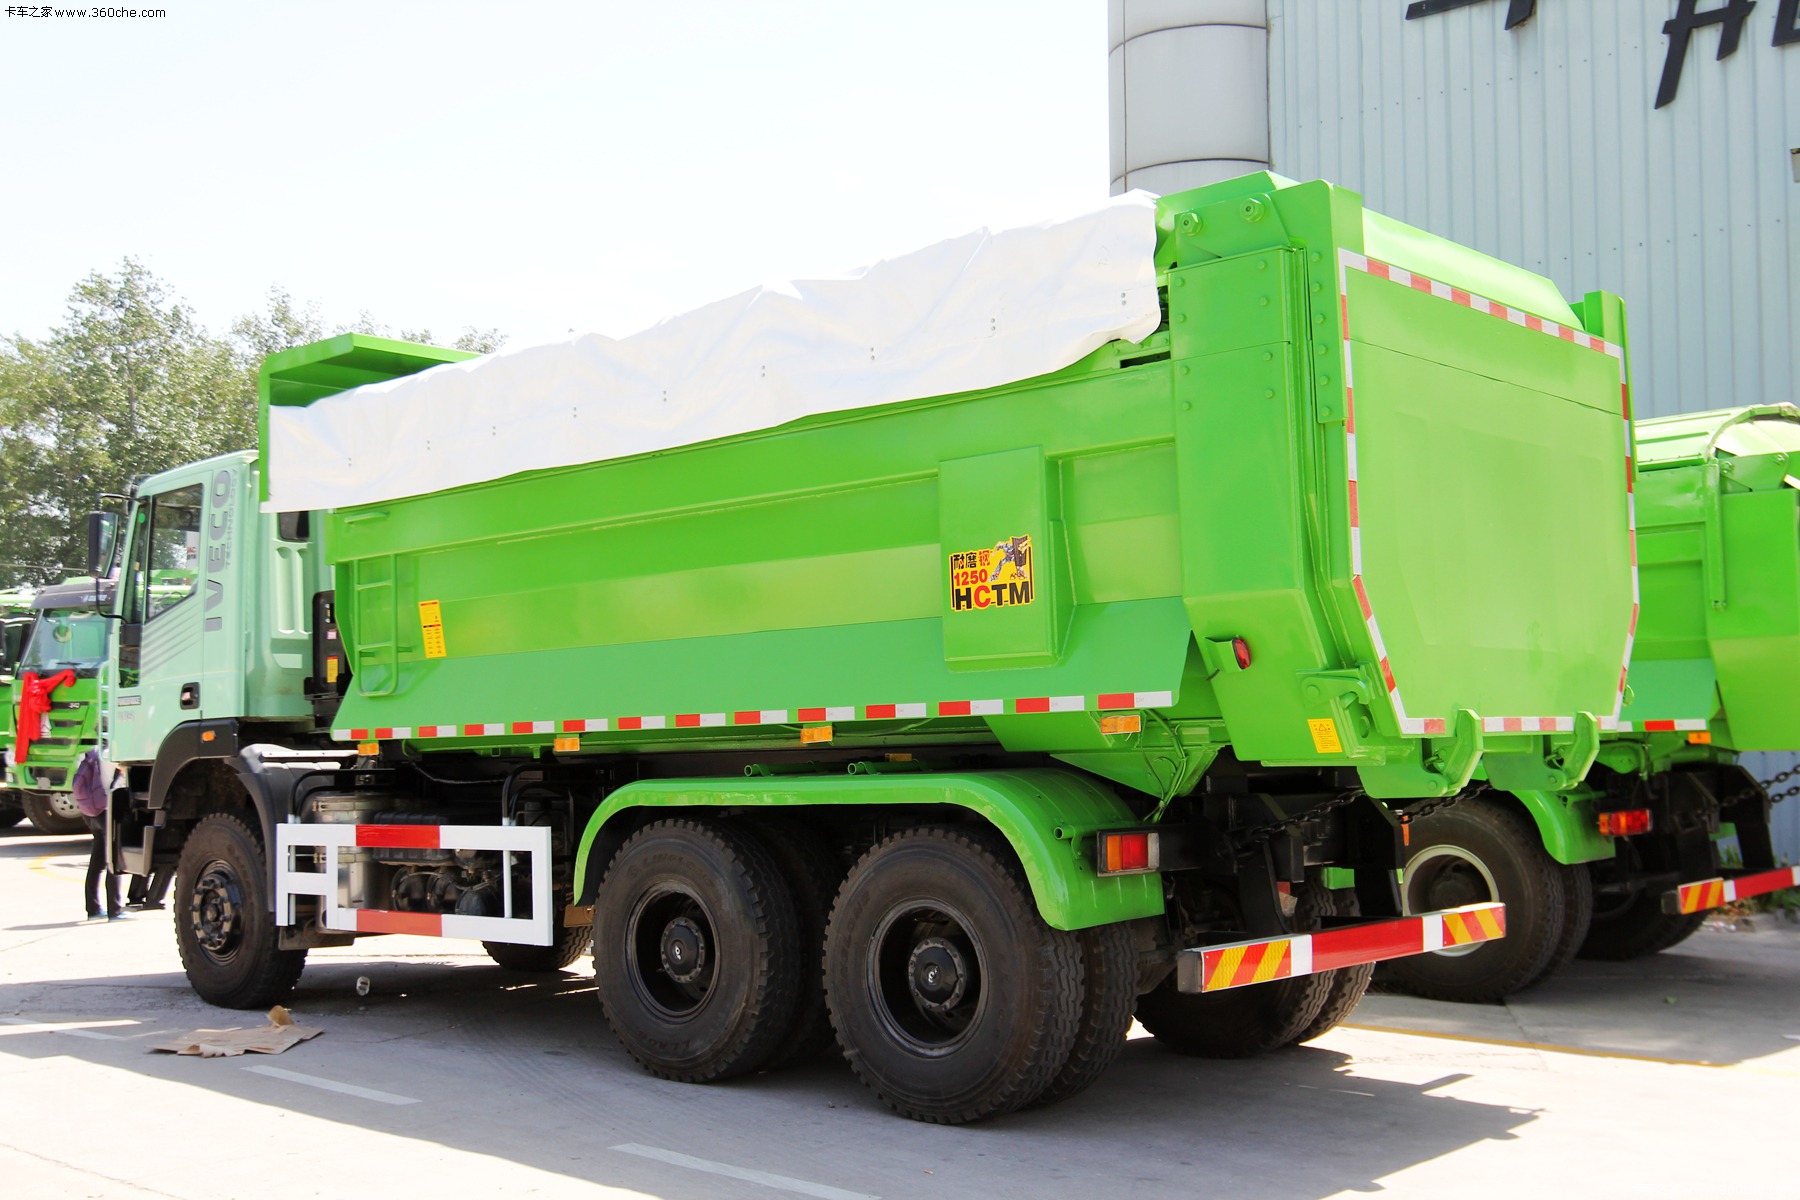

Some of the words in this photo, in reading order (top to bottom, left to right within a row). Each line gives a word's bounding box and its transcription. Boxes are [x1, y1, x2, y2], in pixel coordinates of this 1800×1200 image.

[205, 470, 231, 632] IVECO
[954, 569, 988, 586] 1250
[955, 581, 1030, 610] HCTM
